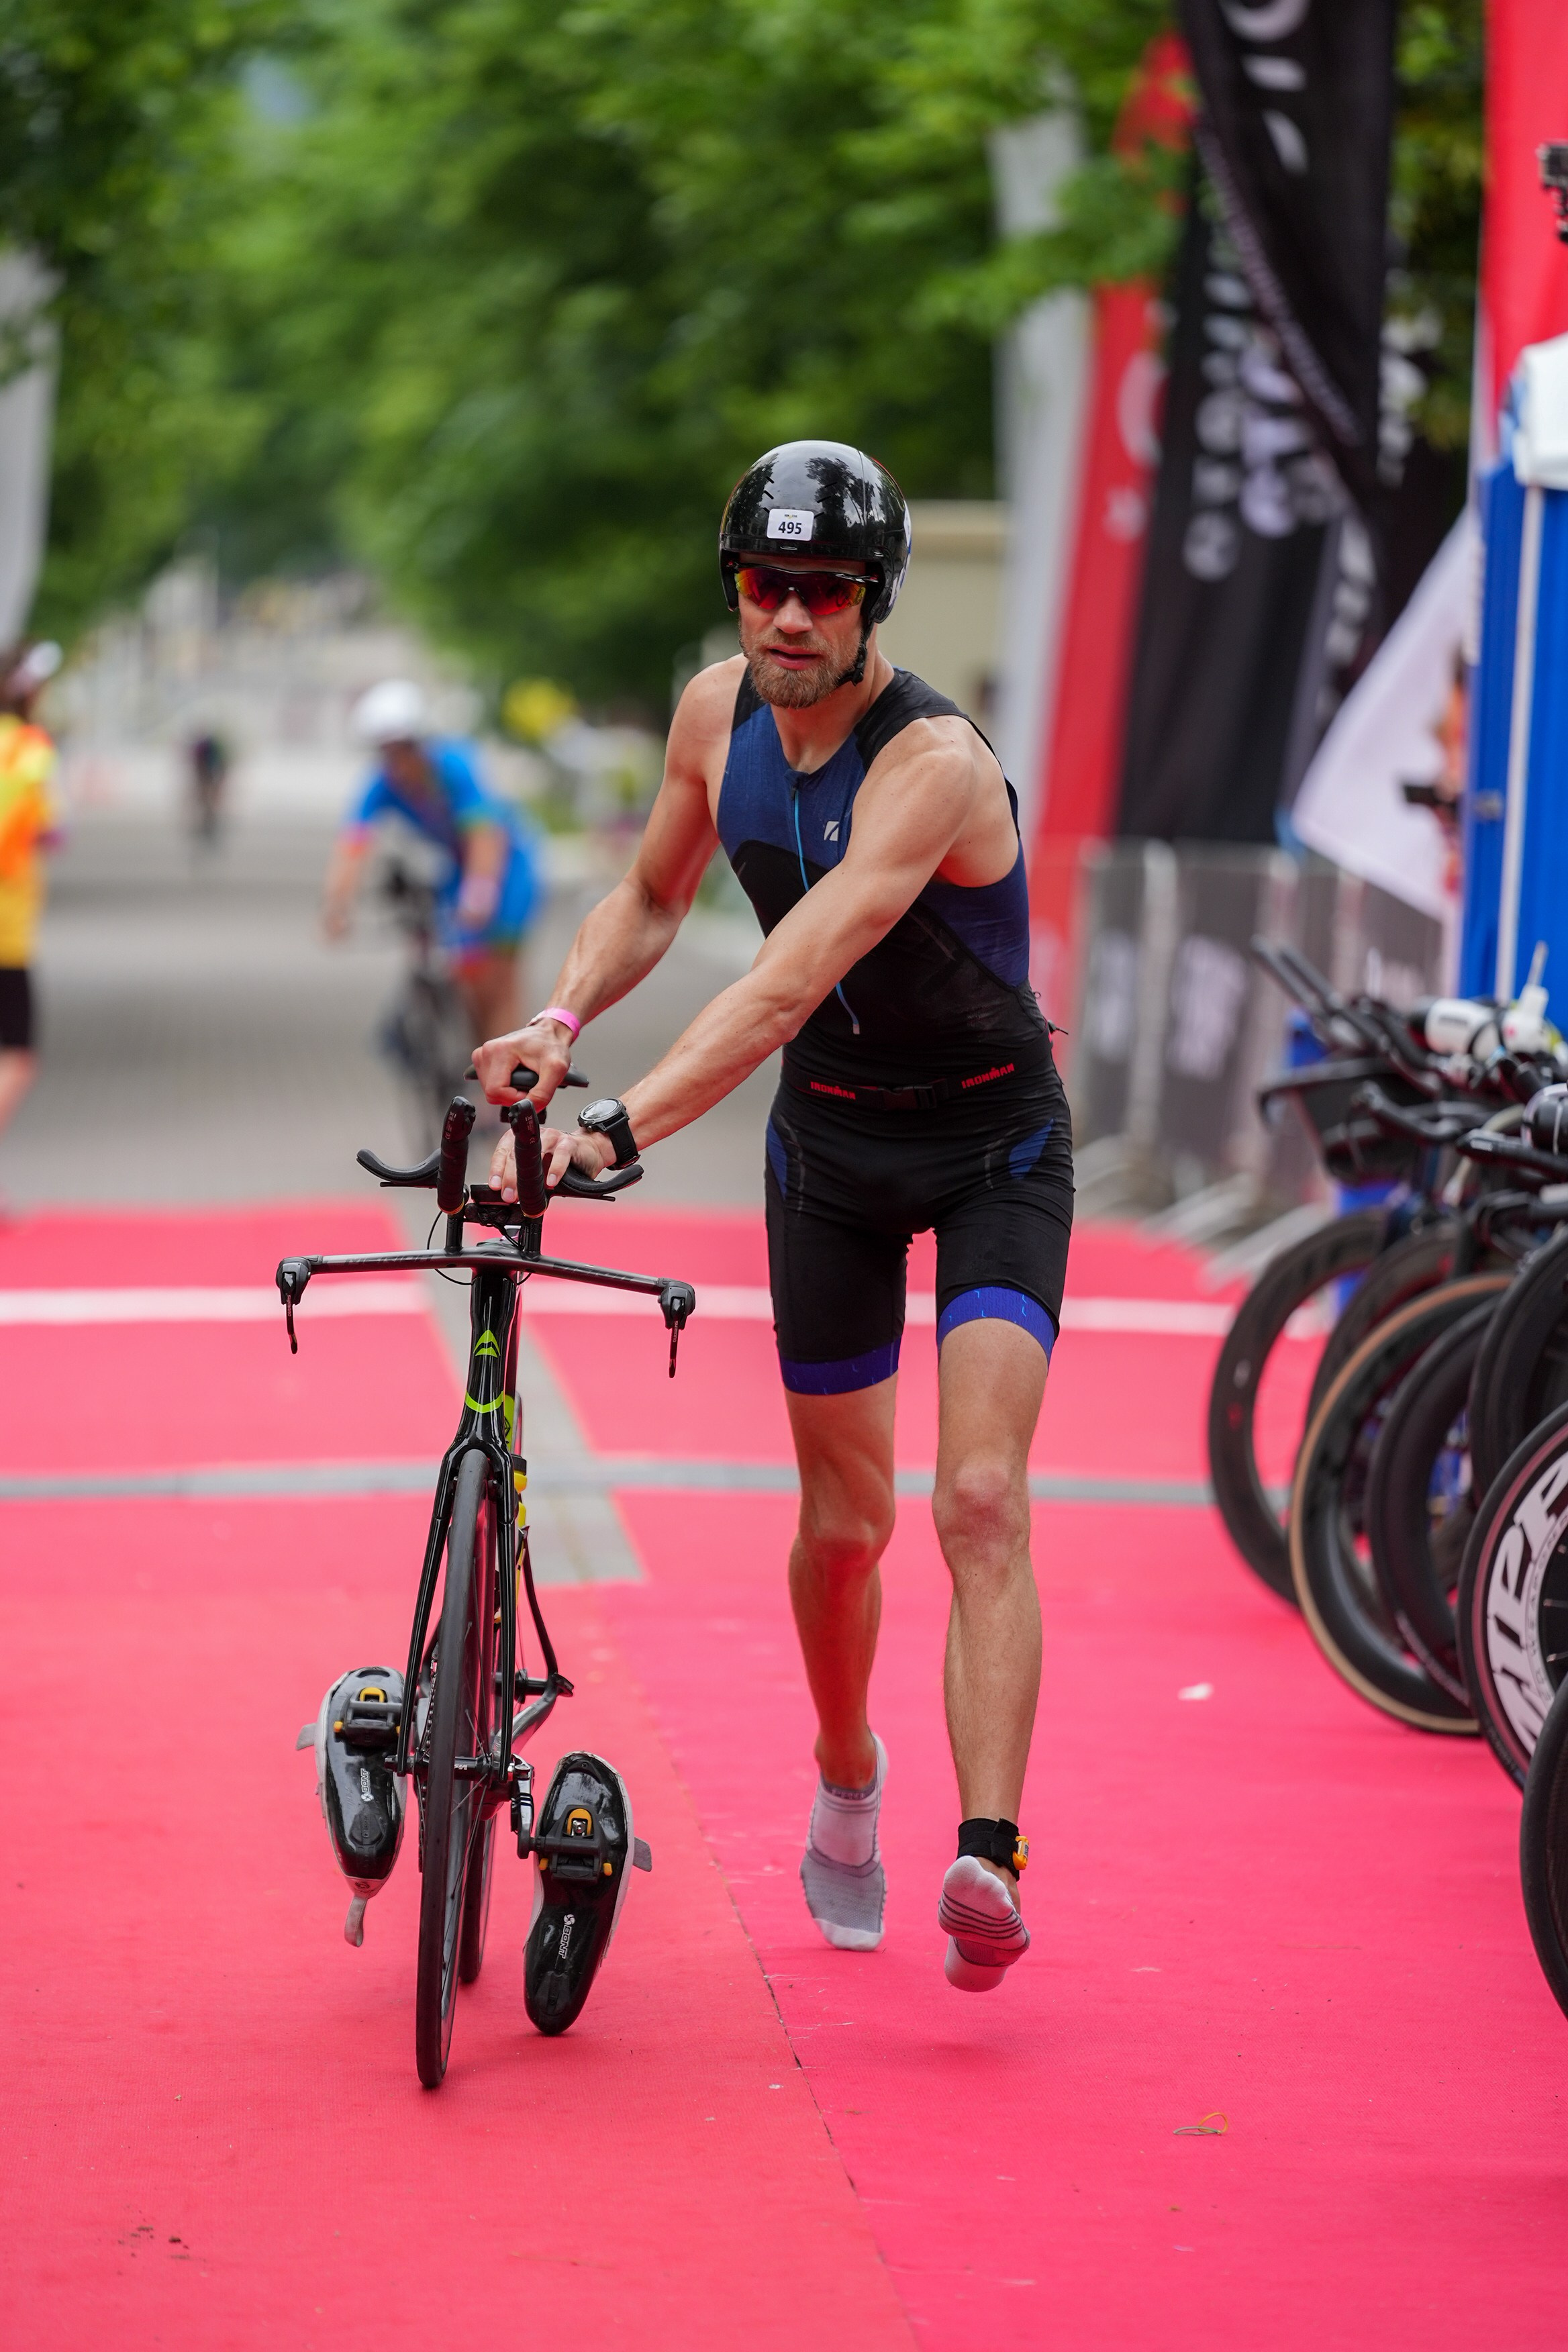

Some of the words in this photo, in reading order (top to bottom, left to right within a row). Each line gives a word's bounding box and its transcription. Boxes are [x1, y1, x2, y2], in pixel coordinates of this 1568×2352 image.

[779, 521, 802, 535] 495
[961, 1063, 1014, 1089] IRONMAN
[810, 1081, 856, 1099] IRONMAN
[360, 1768, 372, 1794] BONT
[558, 1924, 573, 1959] BONT
